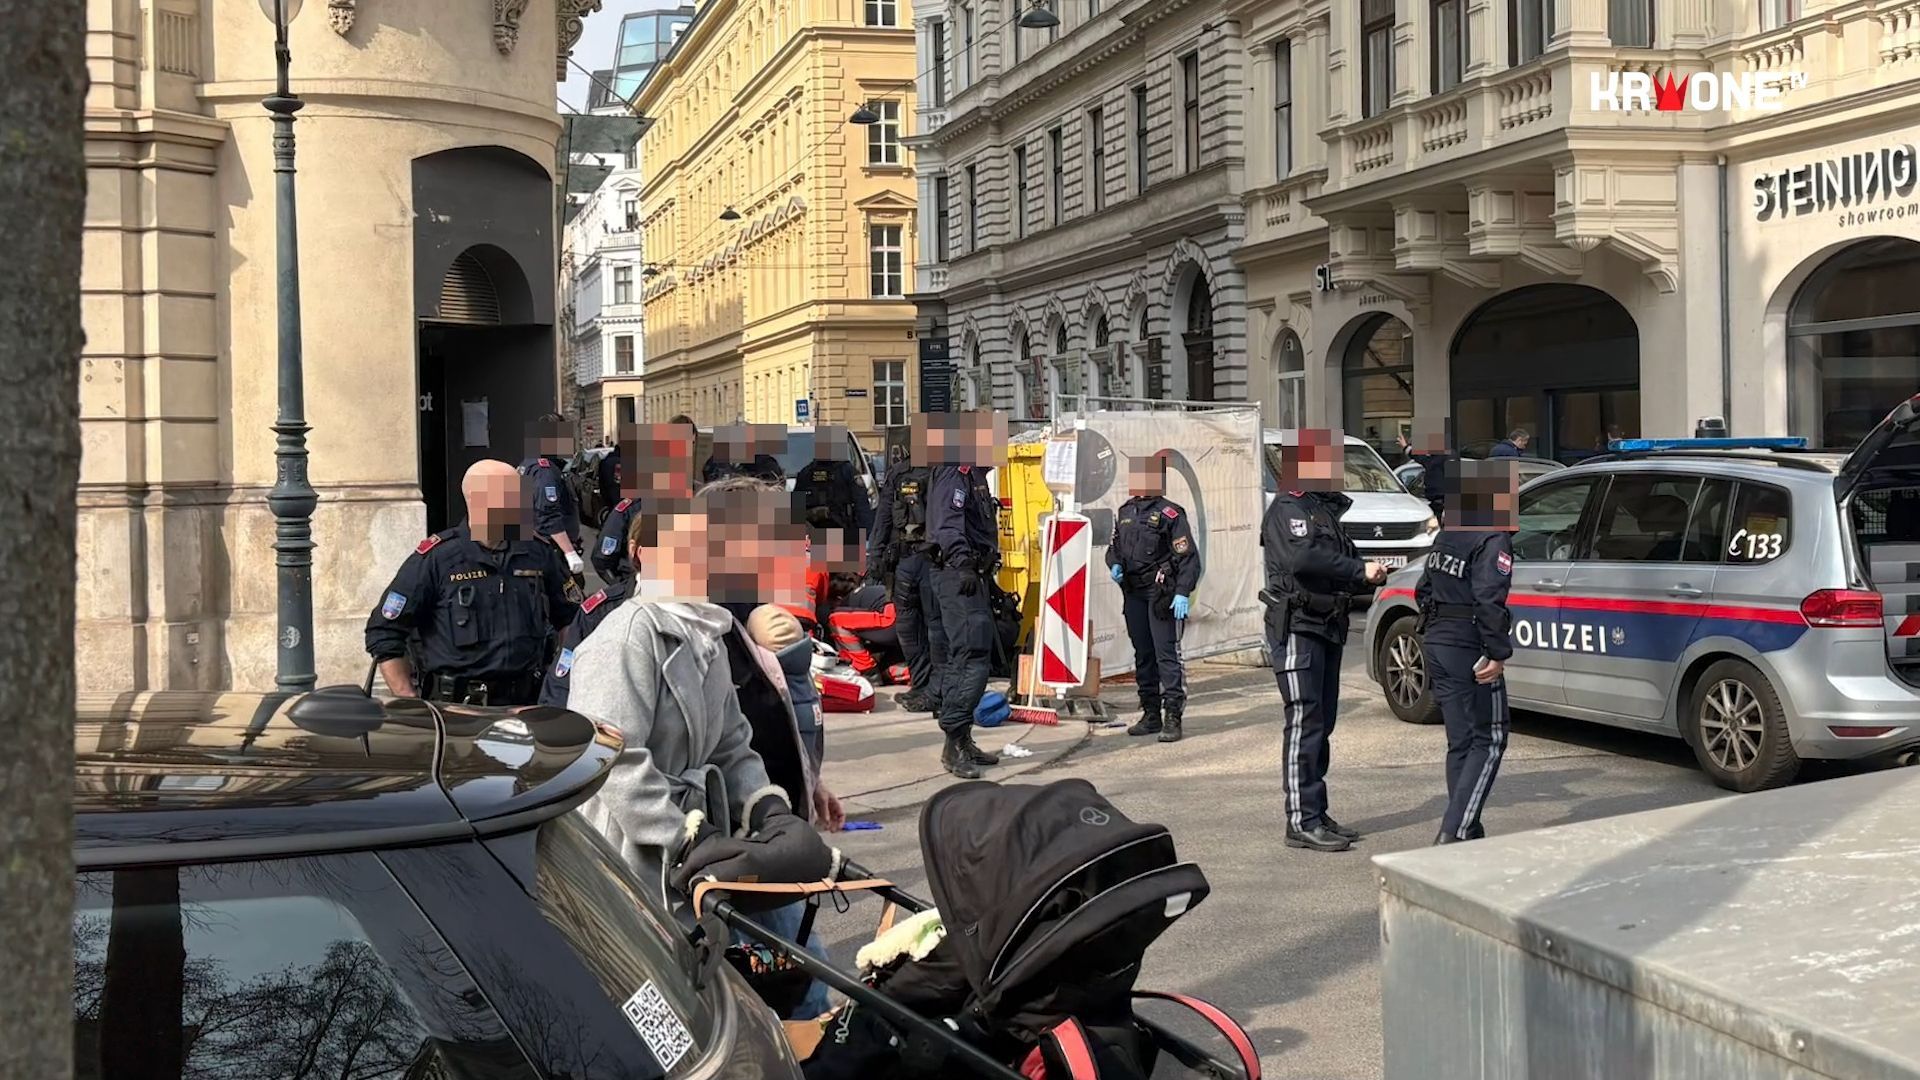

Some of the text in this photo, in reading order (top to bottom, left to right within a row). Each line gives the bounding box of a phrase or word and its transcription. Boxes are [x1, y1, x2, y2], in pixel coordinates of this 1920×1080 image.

[1838, 203, 1919, 228] showroom
[1746, 533, 1782, 559] 133
[450, 570, 488, 582] POLIZEI
[1508, 619, 1607, 653] OLIZEI
